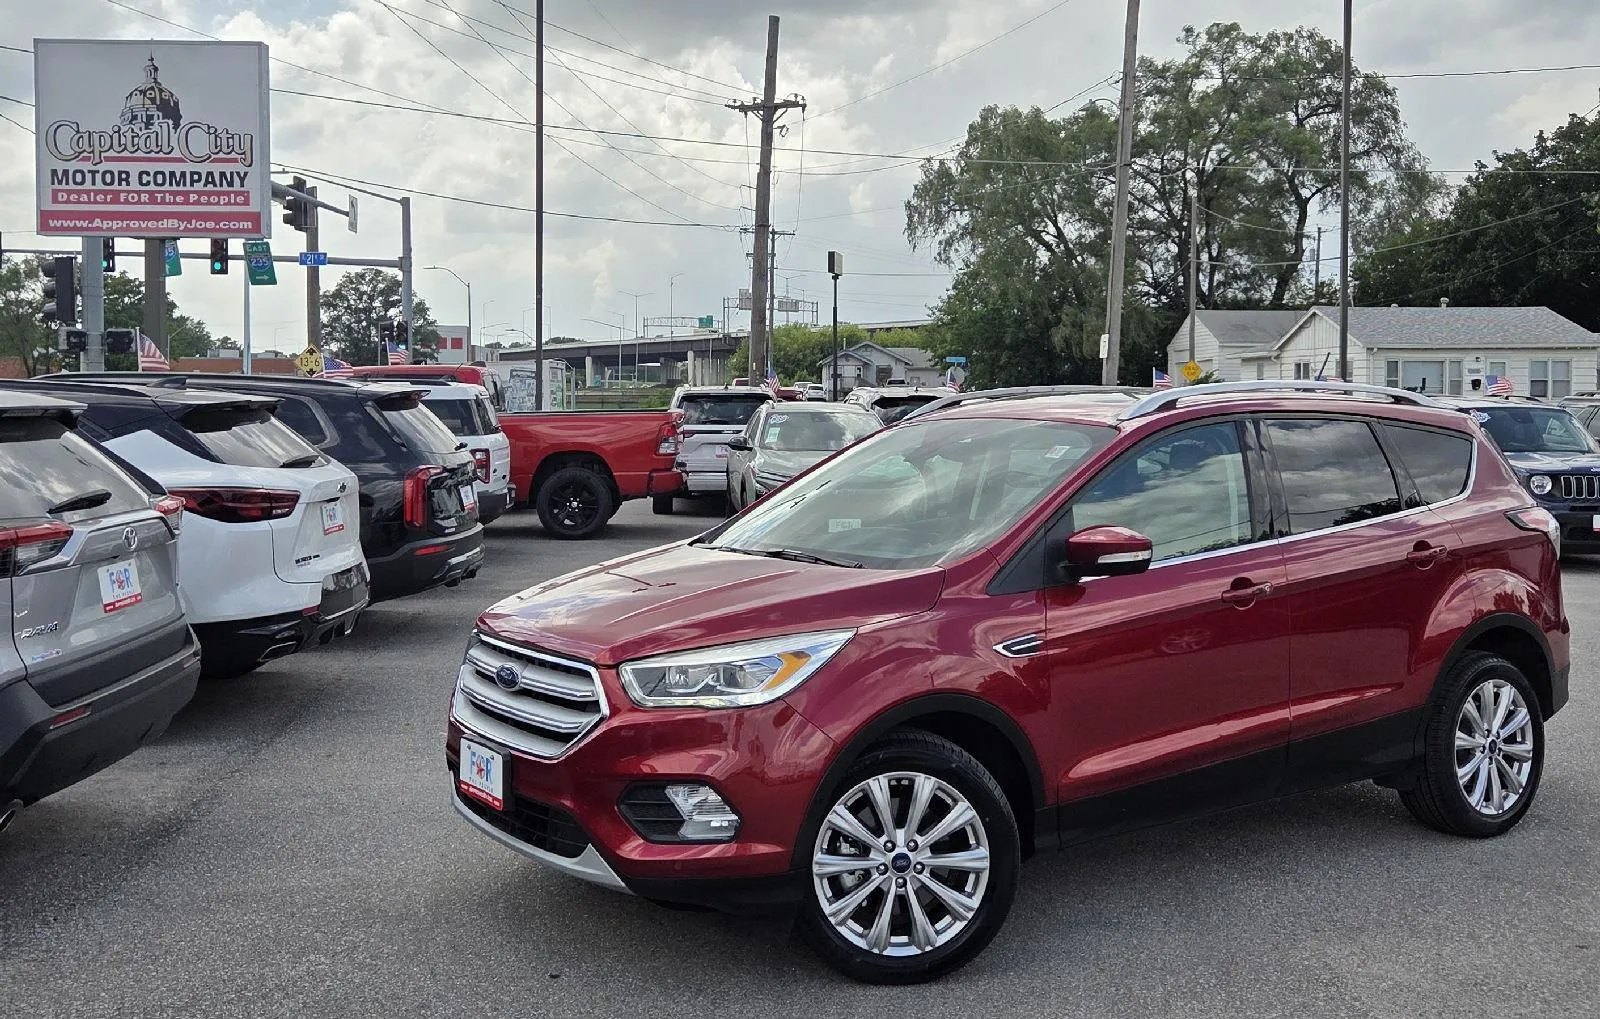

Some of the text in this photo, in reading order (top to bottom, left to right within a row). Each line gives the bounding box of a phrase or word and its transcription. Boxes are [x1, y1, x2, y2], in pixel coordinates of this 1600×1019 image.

[45, 119, 253, 167] Capital City
[50, 168, 249, 188] MOTOR COMPANY
[57, 192, 245, 205] Dealer FOR The People
[48, 218, 253, 230] www.ApprovedByJoe.com
[251, 258, 269, 267] 235
